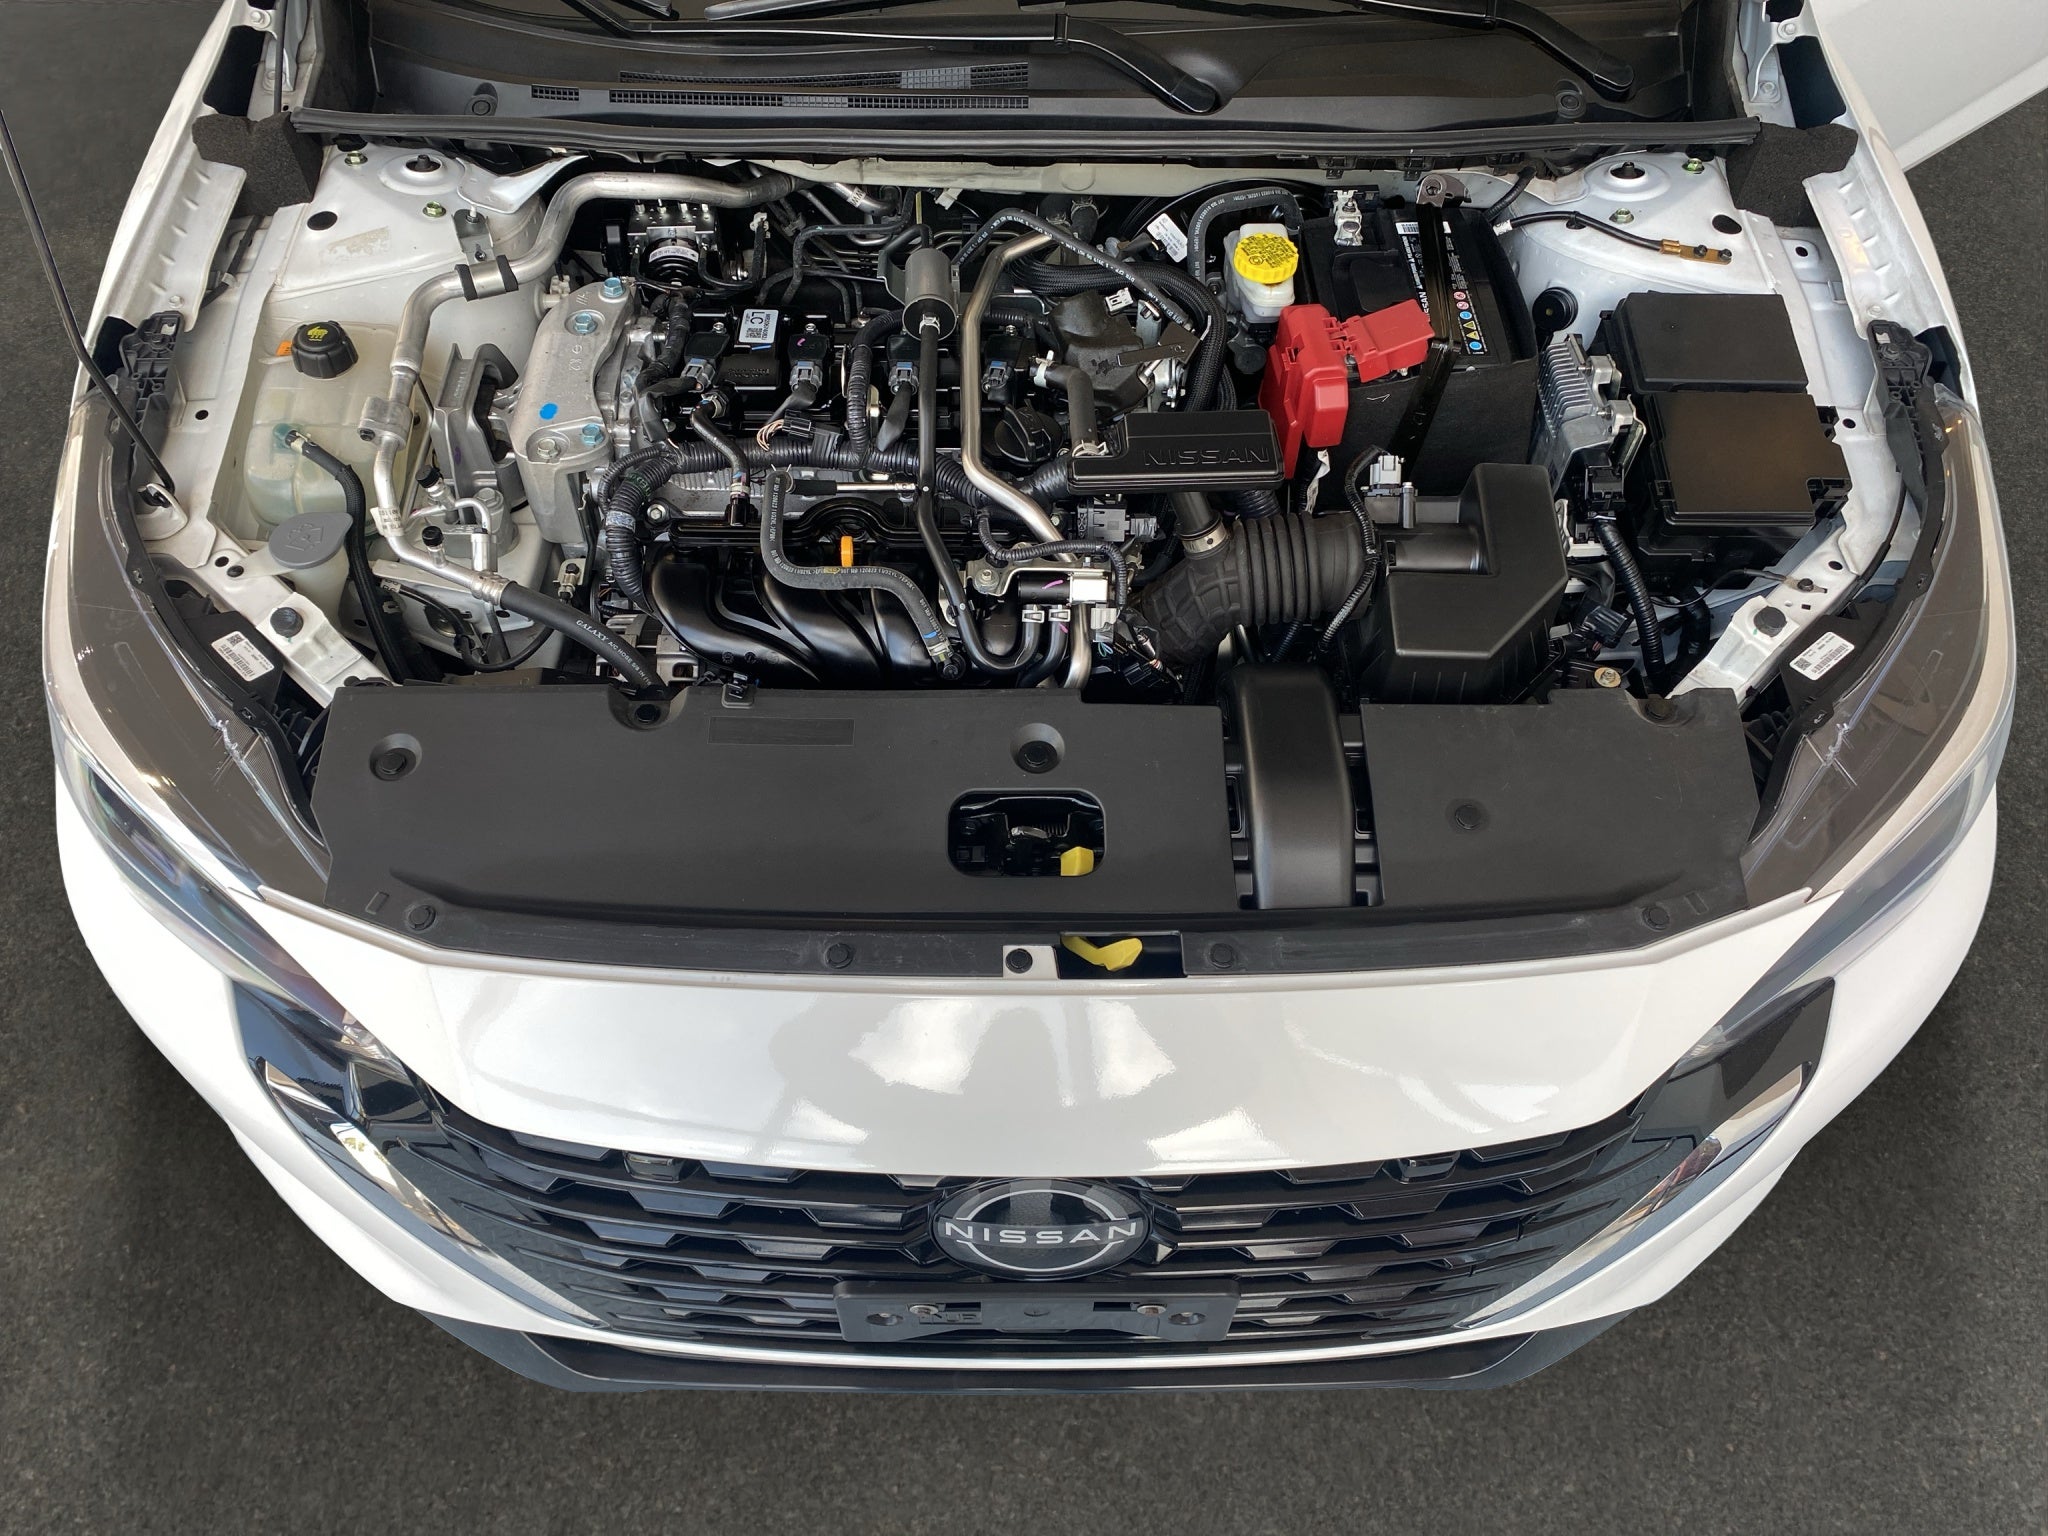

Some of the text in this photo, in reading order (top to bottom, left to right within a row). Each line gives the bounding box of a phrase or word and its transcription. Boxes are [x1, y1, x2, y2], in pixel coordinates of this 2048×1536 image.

[751, 311, 766, 324] LC
[1143, 447, 1270, 466] NISSAN
[575, 619, 609, 641] GALAXY
[607, 641, 619, 650] A/C
[617, 648, 633, 664] HOSE
[944, 1221, 1137, 1245] NISSAN
